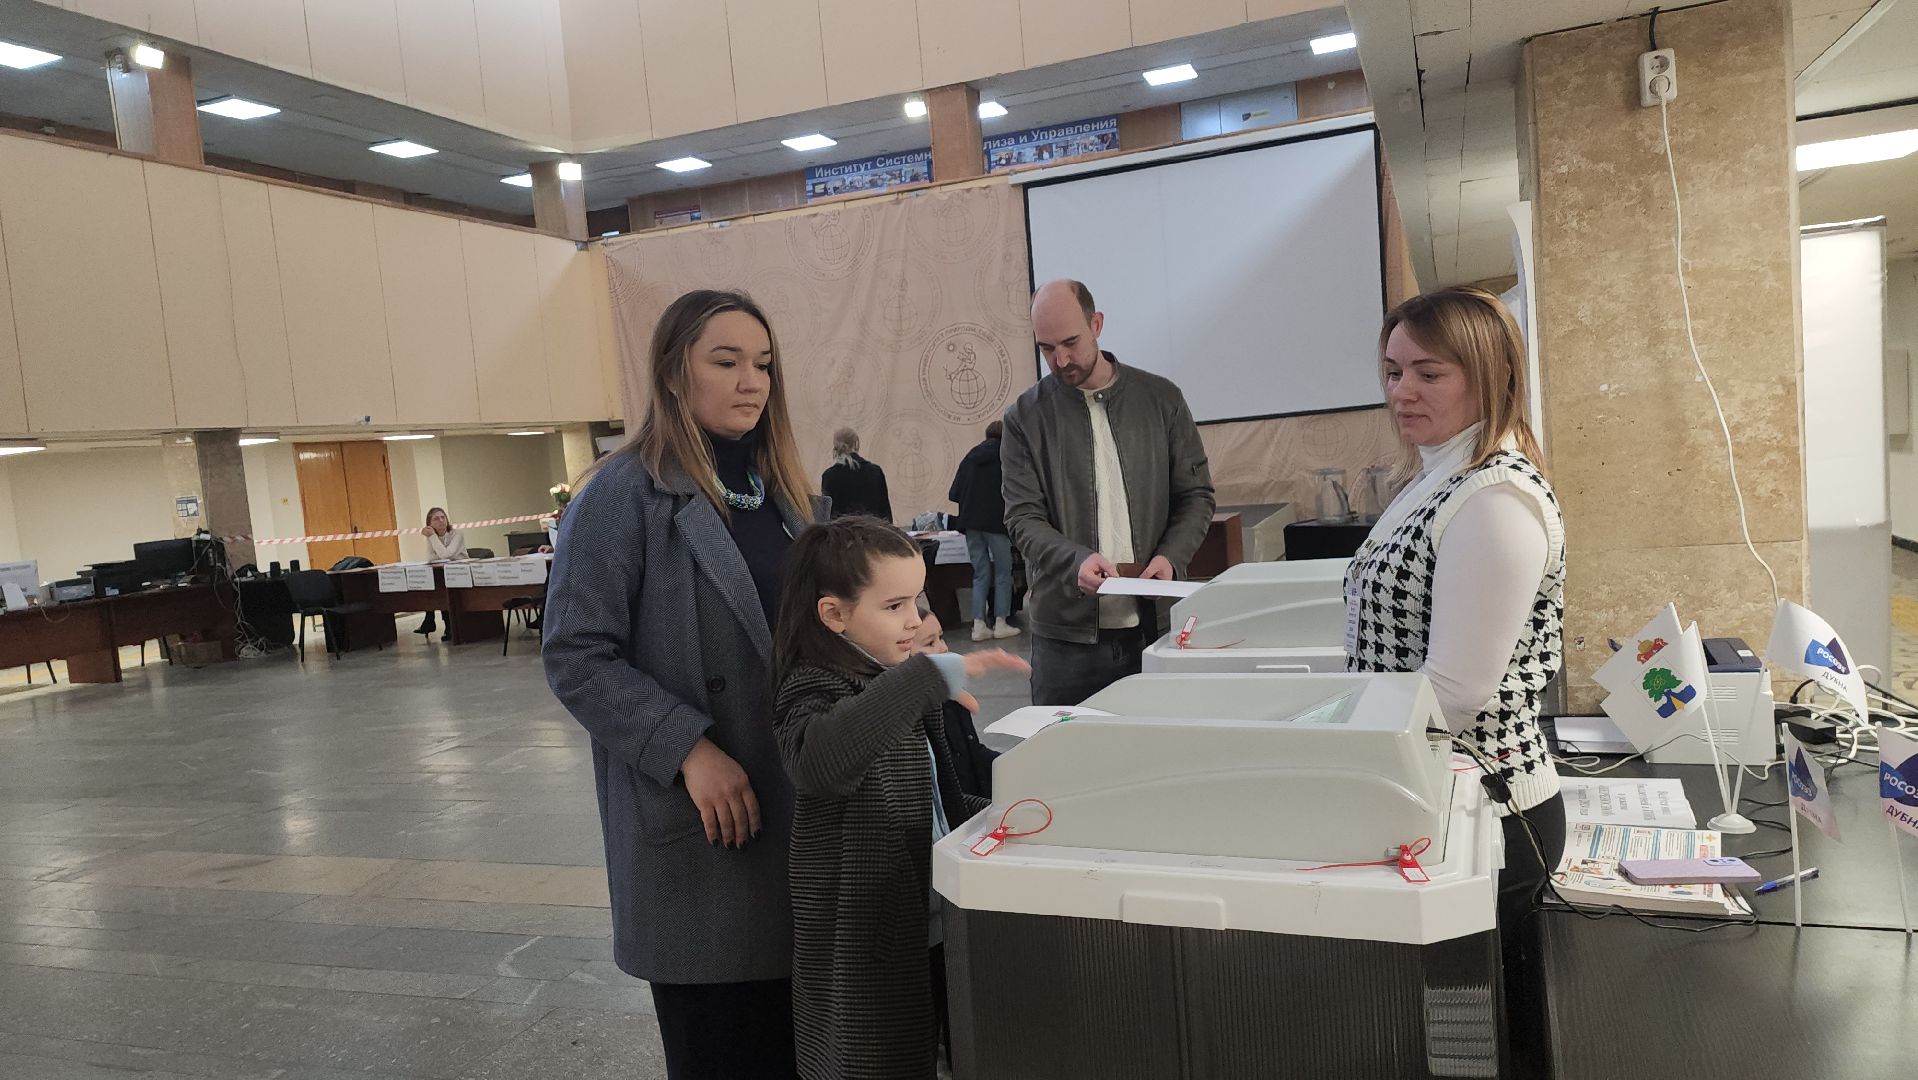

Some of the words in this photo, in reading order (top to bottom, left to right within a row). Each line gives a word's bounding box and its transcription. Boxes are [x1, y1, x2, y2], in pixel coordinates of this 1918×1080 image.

[1019, 135, 1028, 143] и
[1031, 118, 1117, 141] Управления
[814, 160, 873, 178] Институт
[1885, 804, 1918, 830] ДУБН
